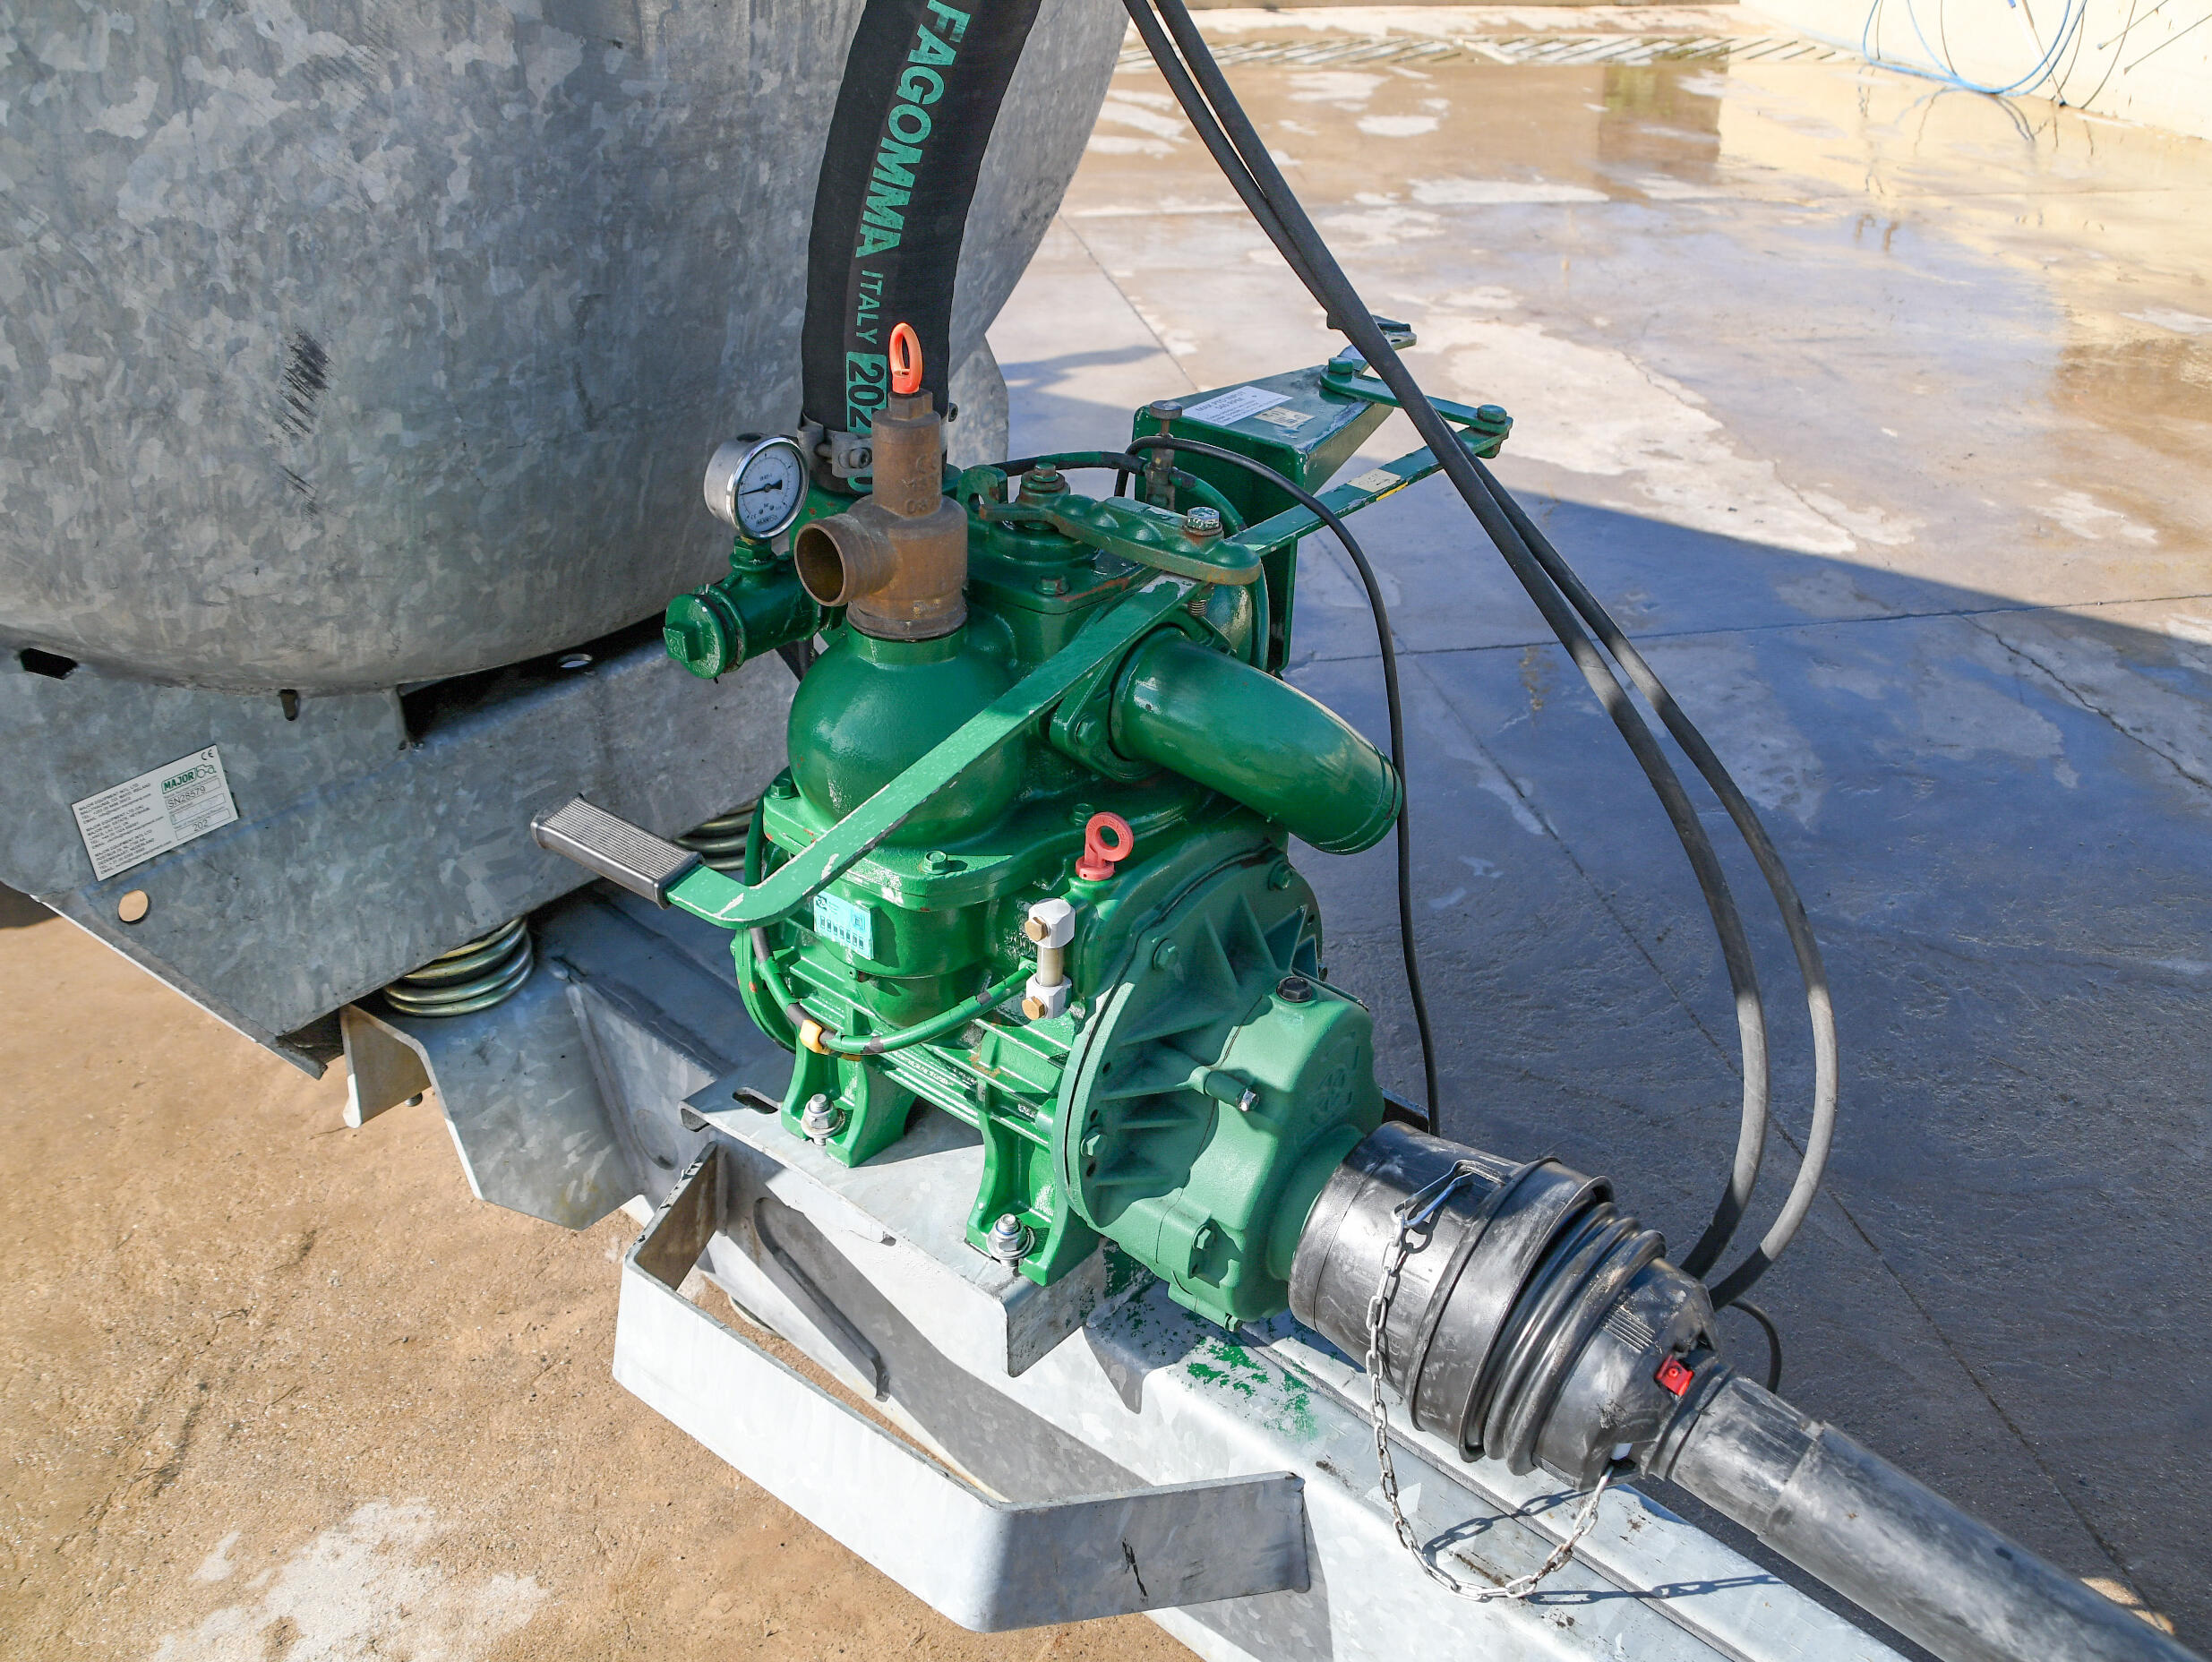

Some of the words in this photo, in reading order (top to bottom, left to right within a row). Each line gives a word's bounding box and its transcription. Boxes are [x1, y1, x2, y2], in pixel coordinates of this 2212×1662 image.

[855, 0, 971, 257] FAGOMMA
[856, 270, 883, 345] ITALY
[164, 772, 194, 791] MAJOR
[167, 785, 206, 809] SN28579
